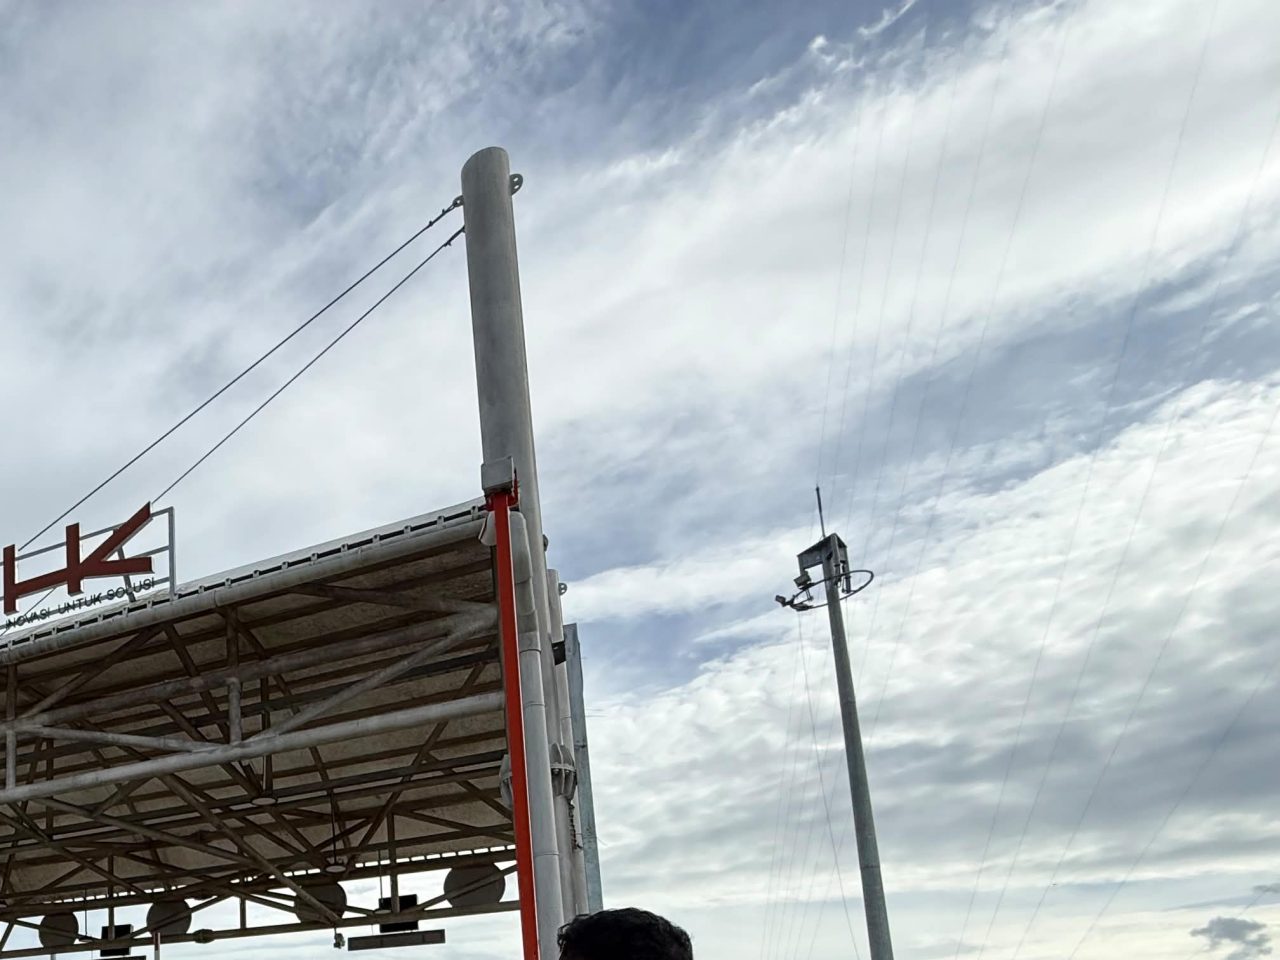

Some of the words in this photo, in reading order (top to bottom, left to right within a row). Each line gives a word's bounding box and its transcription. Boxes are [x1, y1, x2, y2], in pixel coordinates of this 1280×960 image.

[3, 501, 154, 616] HK
[6, 607, 50, 629] INOVASI
[57, 592, 102, 614] UNTUK
[106, 577, 155, 600] SOLUSI
